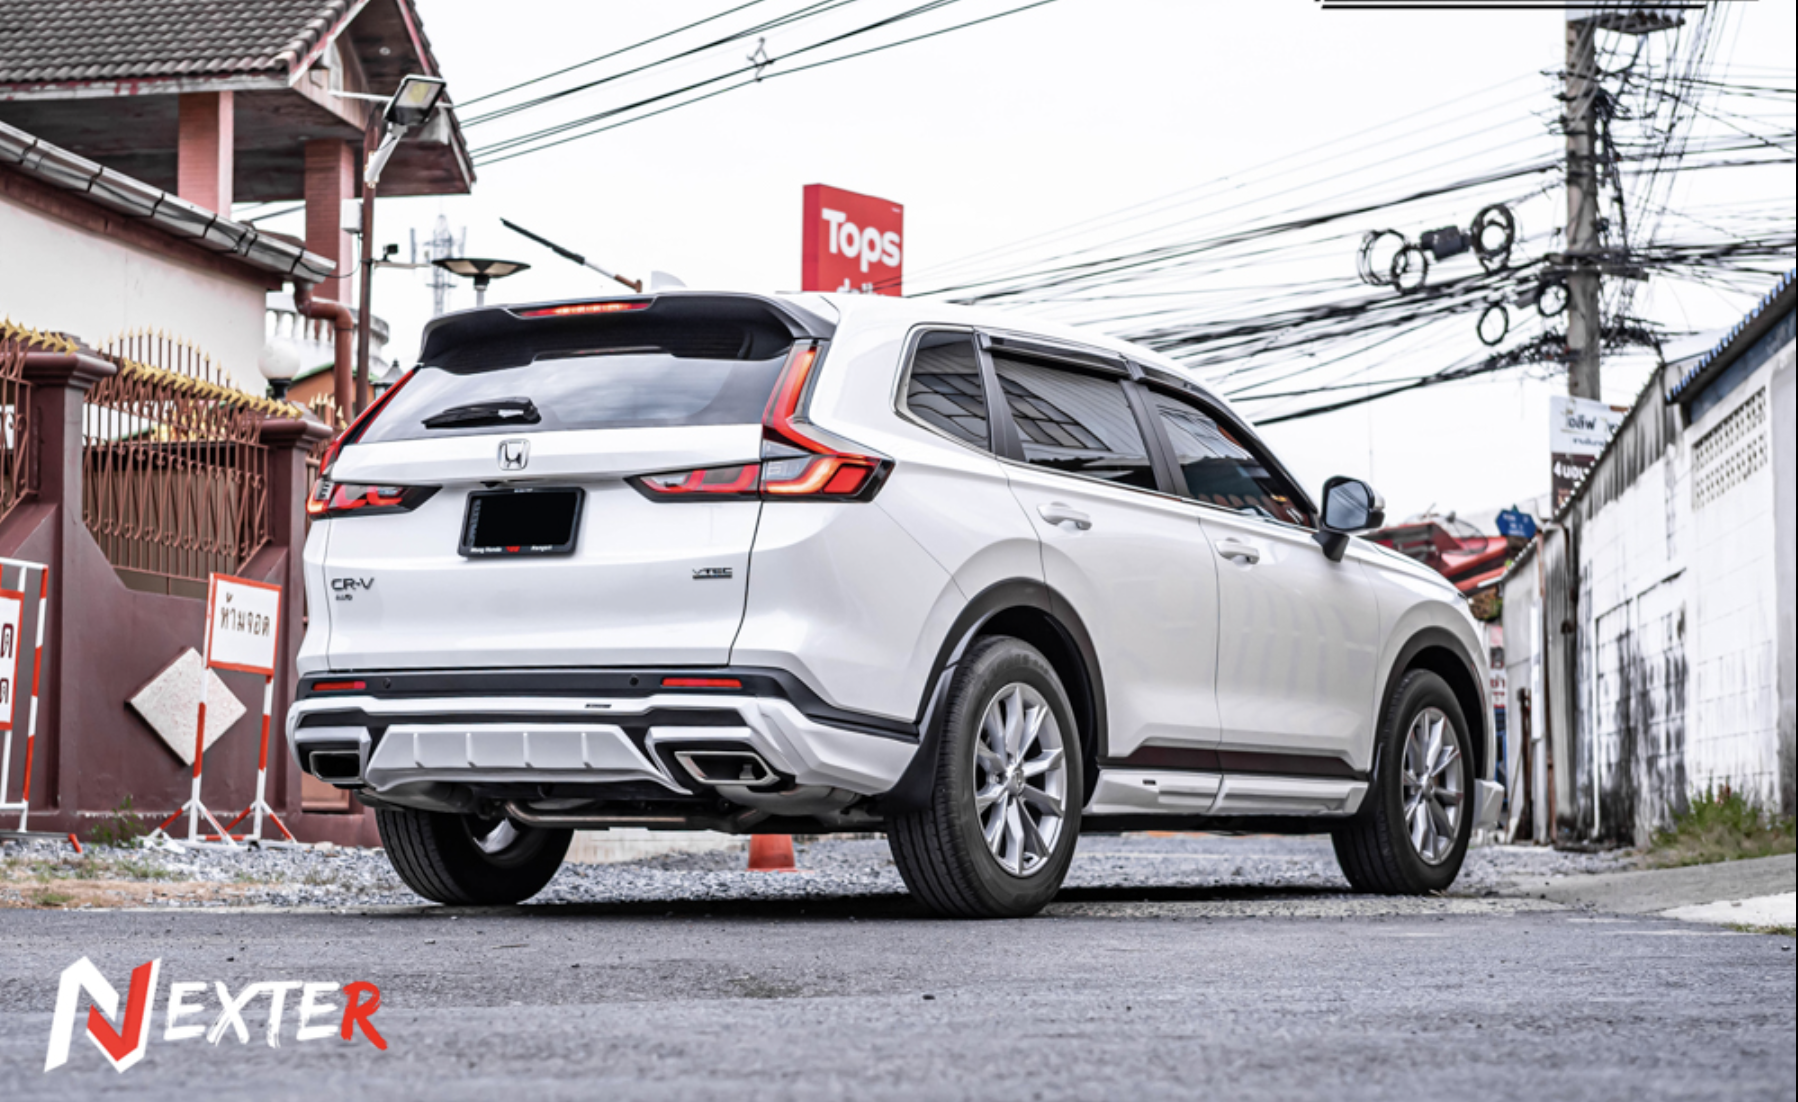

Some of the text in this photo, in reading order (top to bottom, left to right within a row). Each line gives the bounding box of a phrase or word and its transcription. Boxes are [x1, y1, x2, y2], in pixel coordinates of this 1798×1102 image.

[821, 207, 901, 273] Tops
[331, 577, 375, 591] CR-V
[220, 591, 271, 638] ห้ามจอด
